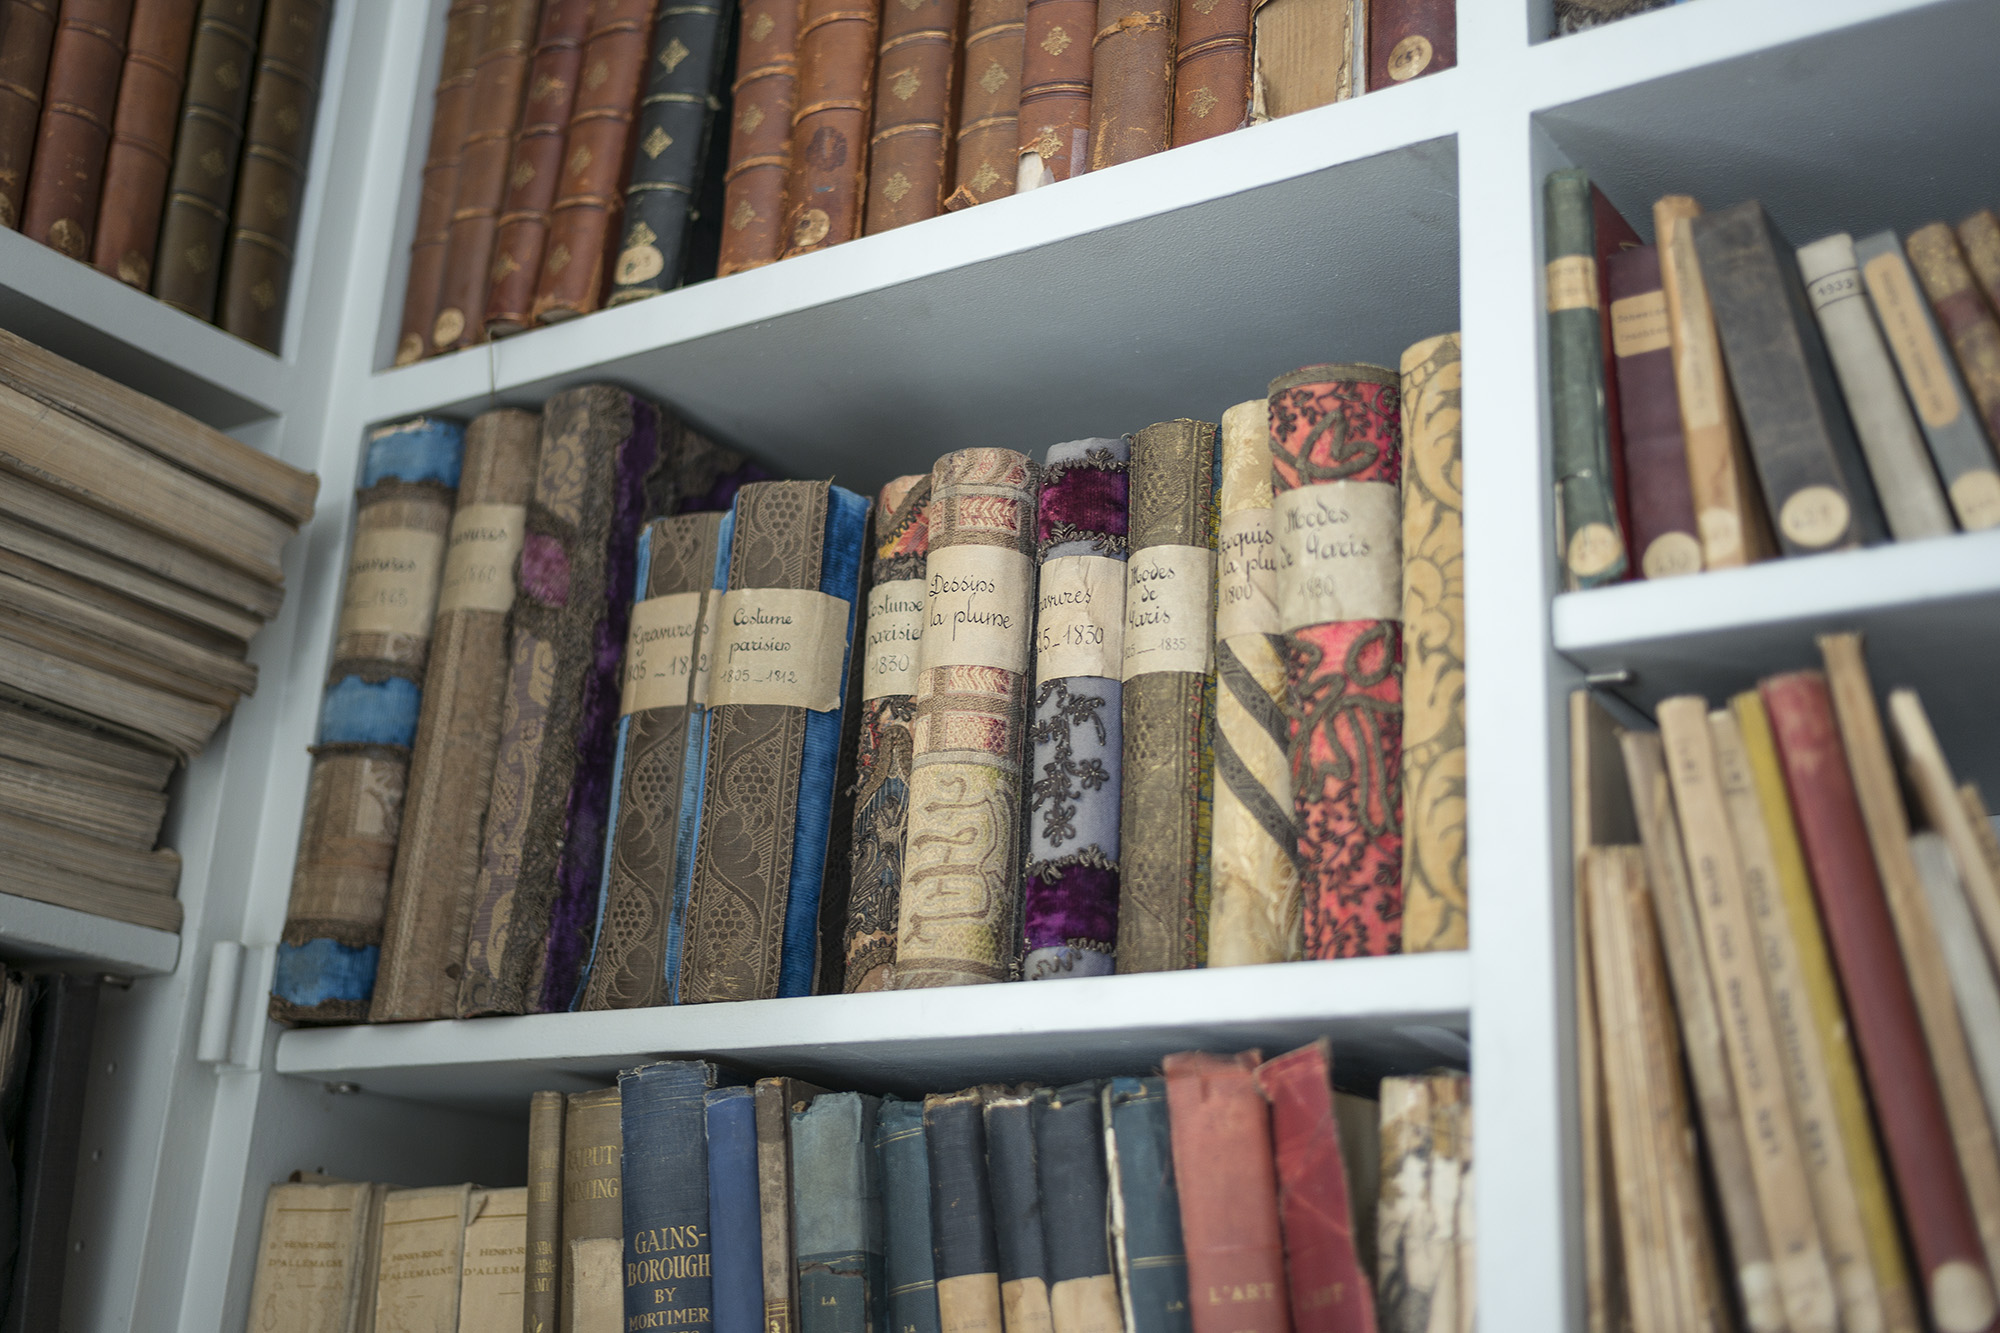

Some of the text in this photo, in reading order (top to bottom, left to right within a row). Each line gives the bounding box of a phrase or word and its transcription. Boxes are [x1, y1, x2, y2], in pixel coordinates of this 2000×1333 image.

[1284, 498, 1349, 534] Modes
[1306, 529, 1372, 561] Paris
[1129, 556, 1175, 590] Modes
[1246, 545, 1277, 582] plu
[928, 573, 996, 598] Dessins
[1141, 584, 1159, 603] de
[733, 607, 793, 627] Costume
[930, 591, 1013, 642] la plume
[1129, 602, 1171, 630] Paris
[728, 636, 791, 664] parisien
[871, 653, 910, 675] 1830
[480, 1247, 525, 1257] HENRY-R
[634, 1225, 707, 1254] GAINS-
[463, 1266, 526, 1276] D'ALLEM
[627, 1253, 712, 1287] BOROUGH
[654, 1287, 677, 1304] BY
[821, 1296, 837, 1306] LA
[1208, 1282, 1275, 1304] L'ART
[629, 1307, 711, 1332] MORTIMER
